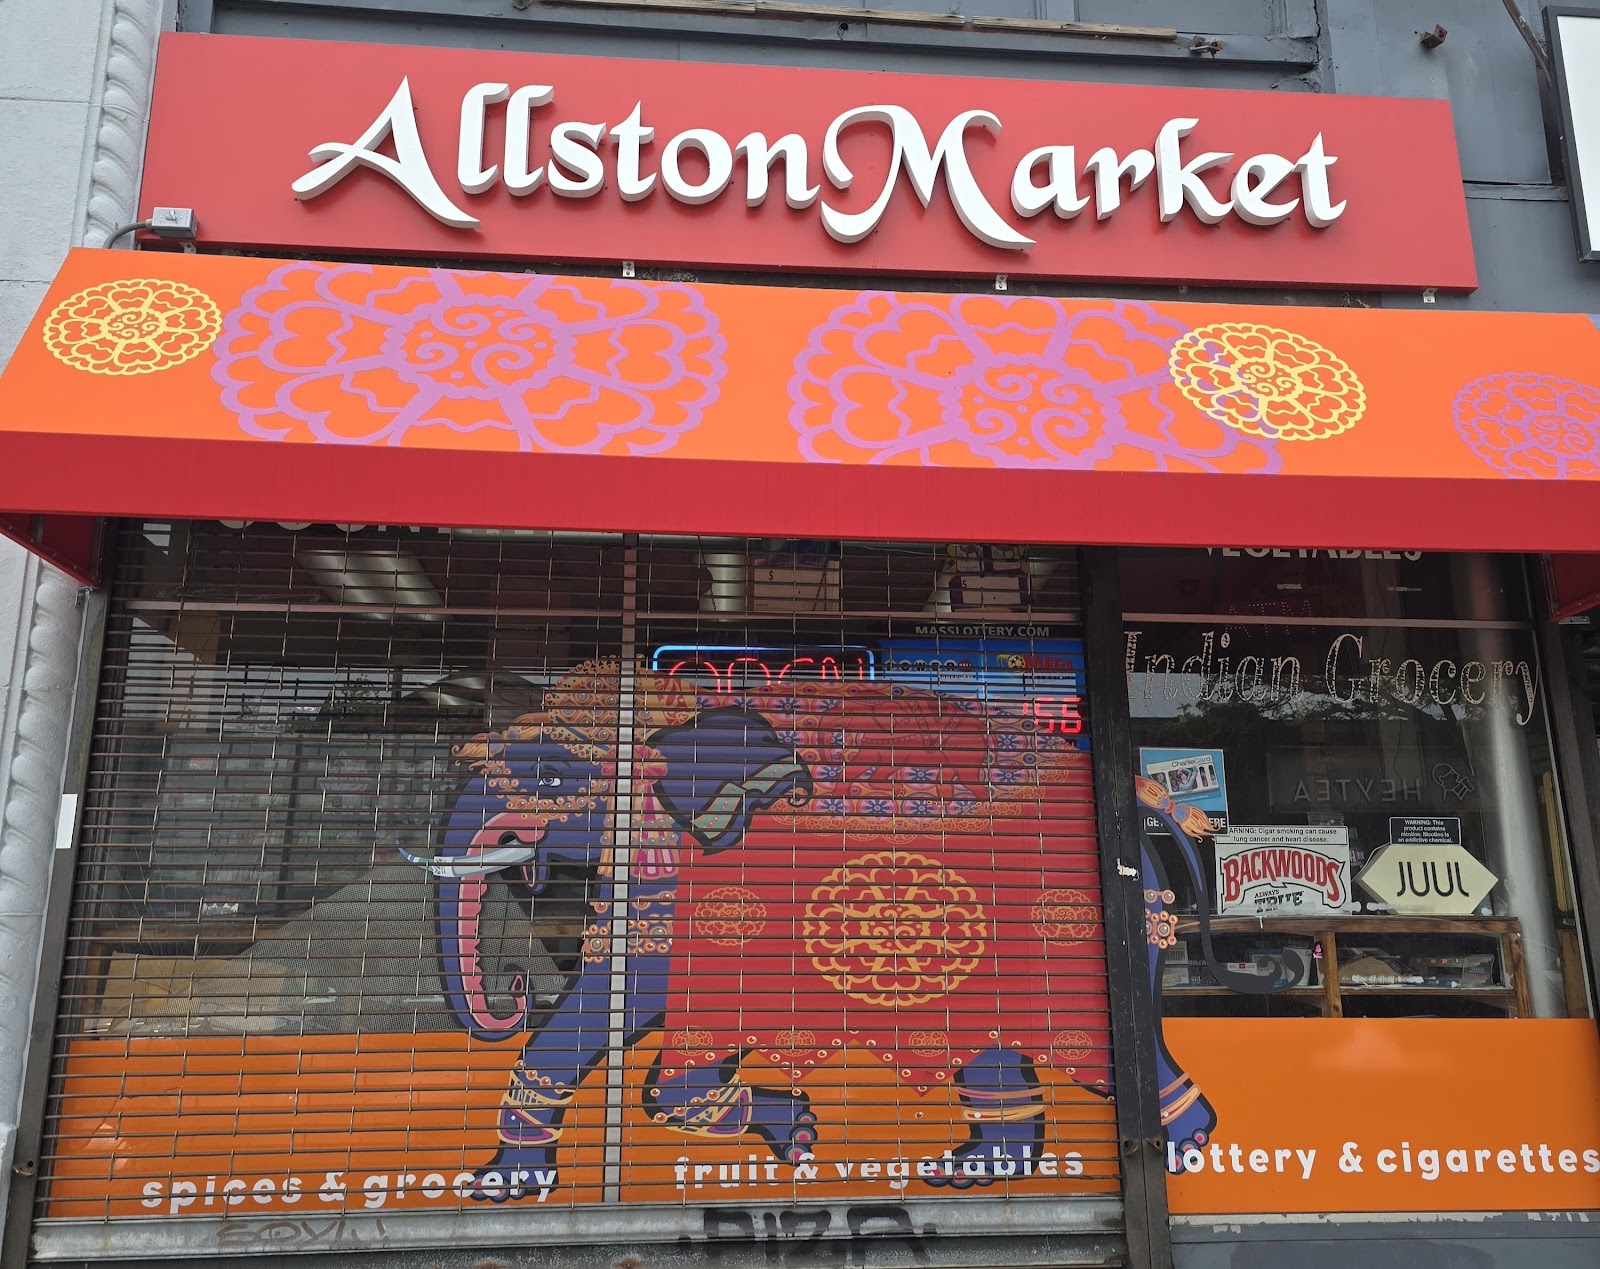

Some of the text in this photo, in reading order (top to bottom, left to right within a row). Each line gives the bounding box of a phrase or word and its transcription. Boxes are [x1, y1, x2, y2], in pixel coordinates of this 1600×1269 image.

[291, 75, 1347, 250] Allston Market
[915, 626, 1050, 637] MASSLOTTERY.COM
[1122, 630, 1541, 726] Indian Grocery
[1171, 756, 1211, 768] CharlieCard
[1146, 816, 1164, 827] GE
[1258, 828, 1275, 836] Cigar
[1276, 828, 1304, 836] smoking
[1223, 849, 1340, 902] BACKWOODS
[1254, 889, 1280, 898] ALWAYS
[1397, 861, 1469, 897] JUUL
[674, 1145, 1084, 1189] fruit & vegetables
[1168, 1141, 1600, 1180] lottery & cigarettes
[141, 1169, 557, 1214] spices & grocery
